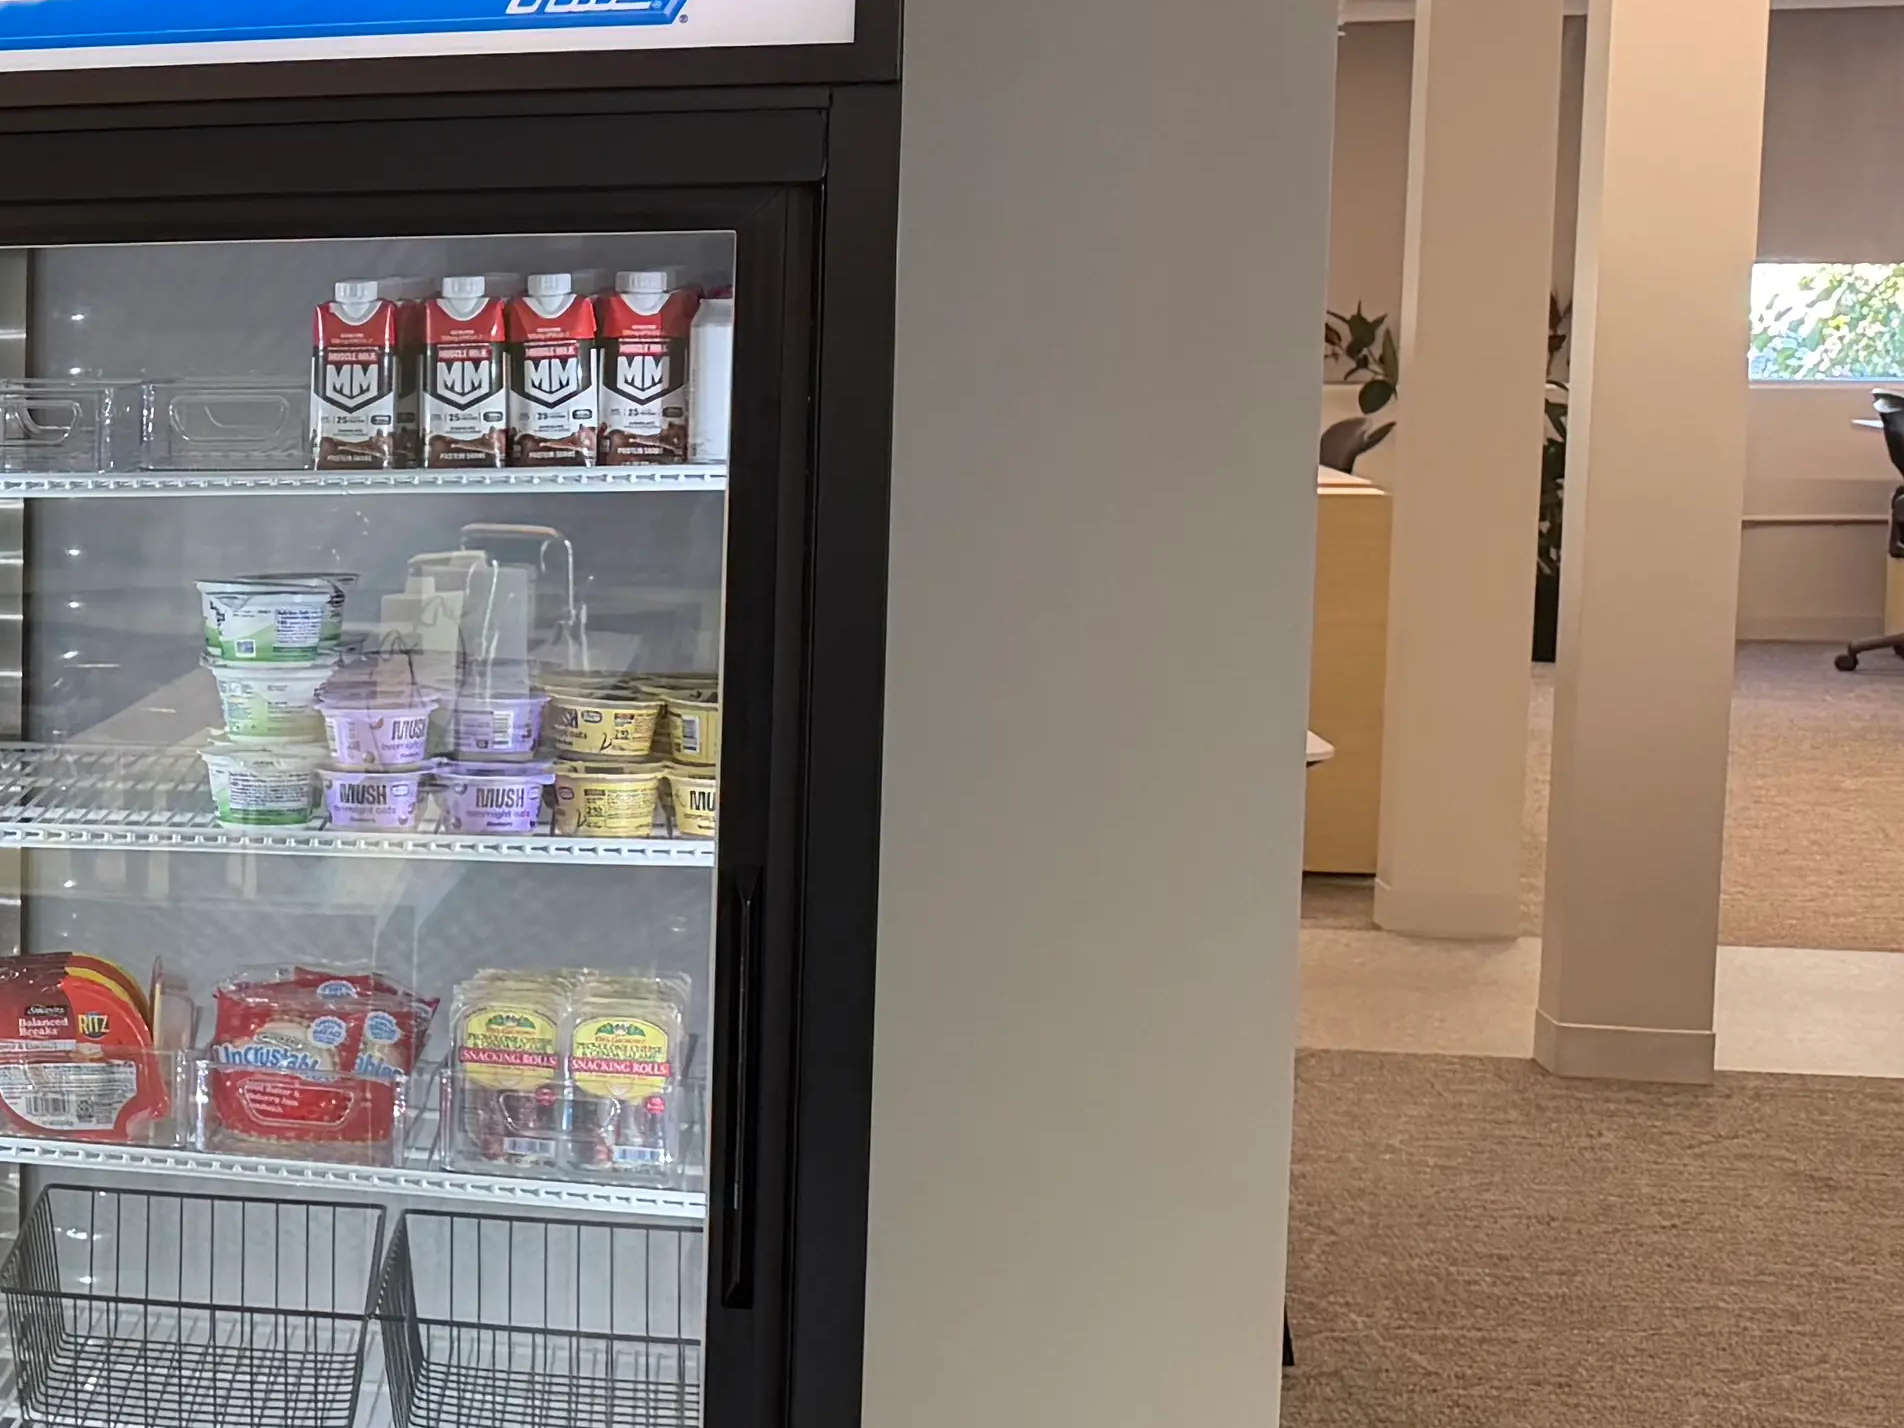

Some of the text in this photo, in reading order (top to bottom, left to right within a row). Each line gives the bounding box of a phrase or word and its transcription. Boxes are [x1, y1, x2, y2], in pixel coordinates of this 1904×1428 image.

[326, 363, 379, 403] MM
[437, 361, 490, 401] MM
[524, 357, 578, 399] MM
[617, 355, 670, 397] MM
[339, 783, 388, 806] MUSH
[475, 787, 525, 809] MUSH
[18, 1018, 69, 1028] Balanced
[19, 1028, 58, 1037] Breaks
[77, 1014, 110, 1033] RITZ
[461, 1050, 557, 1067] SNACKING ROLLS
[572, 1058, 668, 1075] SNACKING ROLLS
